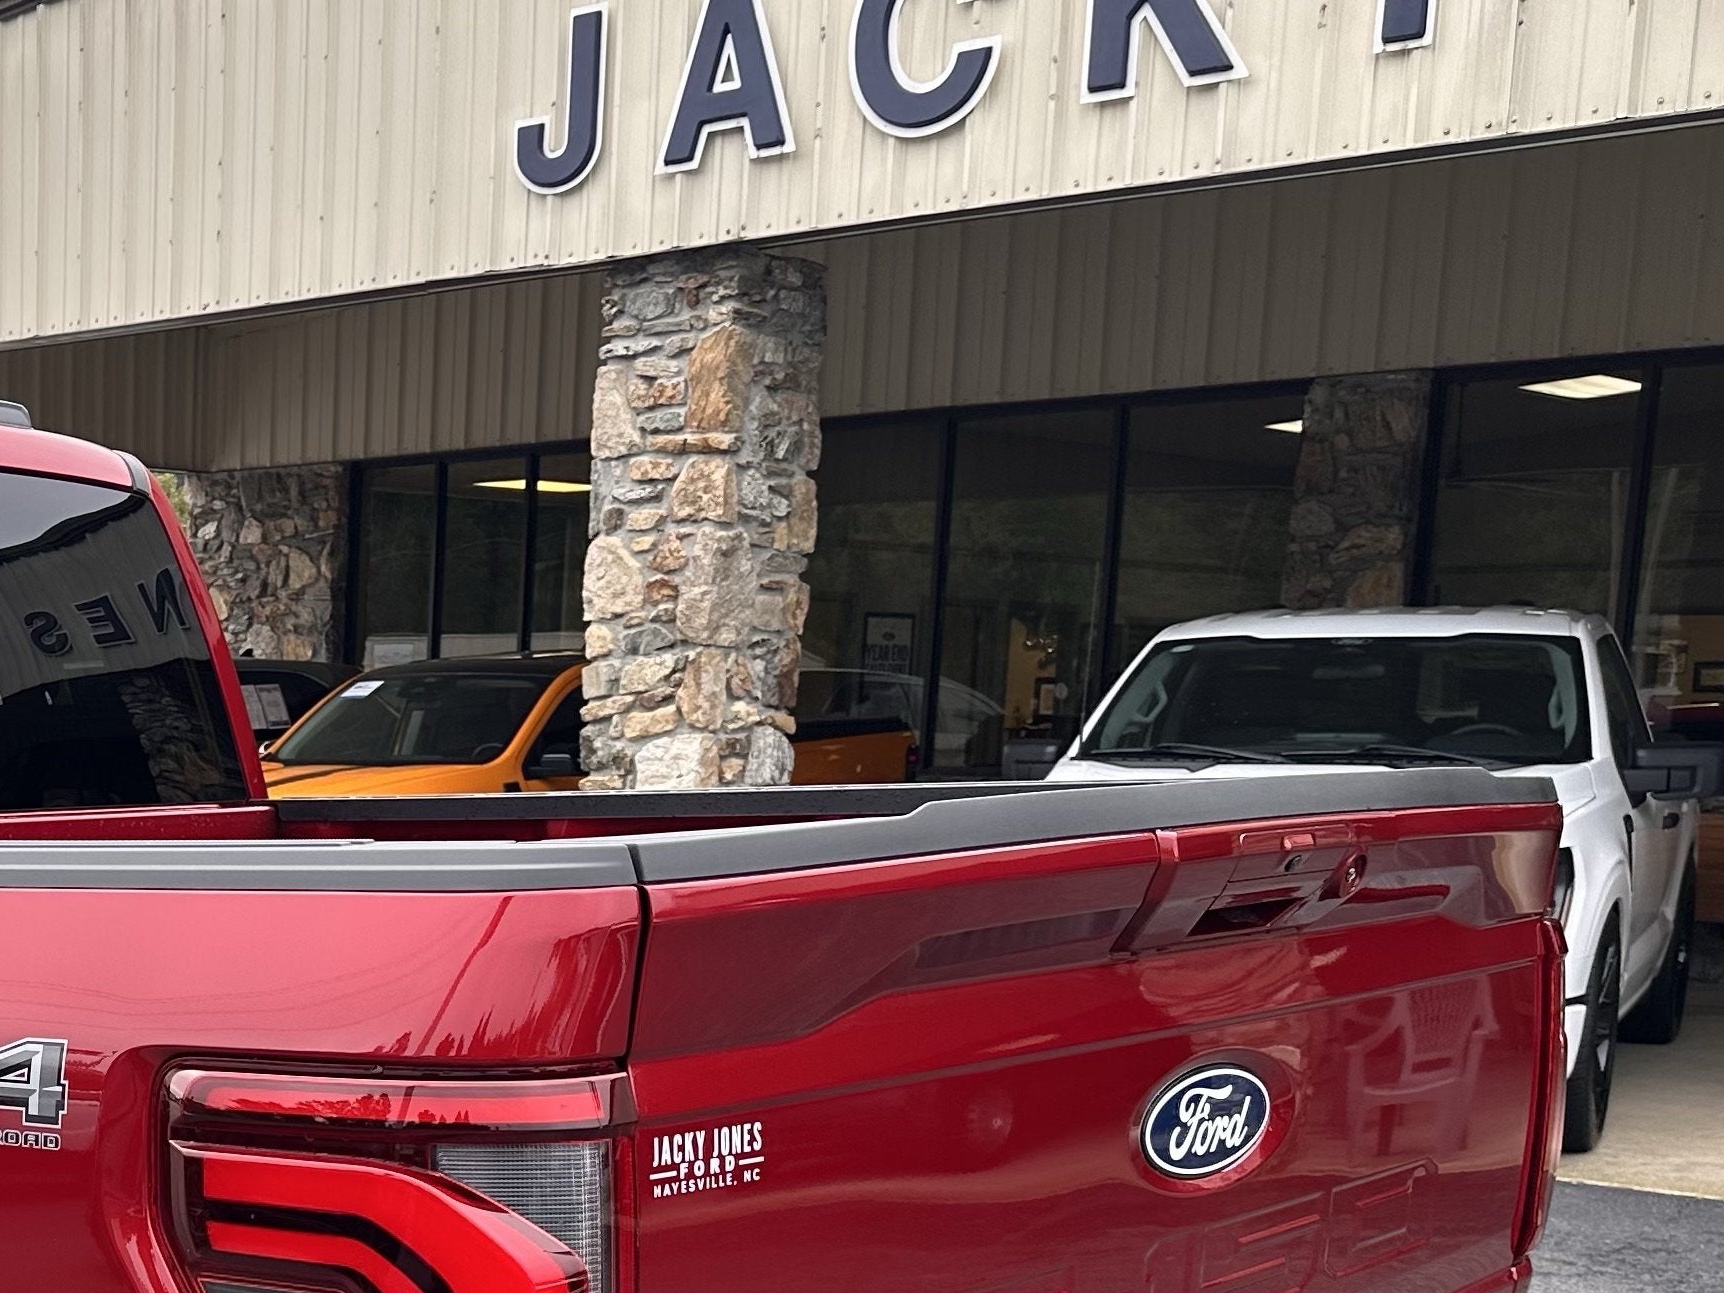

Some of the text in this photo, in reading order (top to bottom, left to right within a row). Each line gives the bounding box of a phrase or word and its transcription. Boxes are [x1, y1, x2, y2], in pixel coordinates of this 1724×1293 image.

[513, 0, 1434, 196] JACK
[652, 1121, 763, 1168] JACKY JONES
[1169, 1084, 1252, 1161] Ford
[653, 1168, 761, 1199] HAYESVILLE, NC
[679, 1155, 736, 1180] FORD
